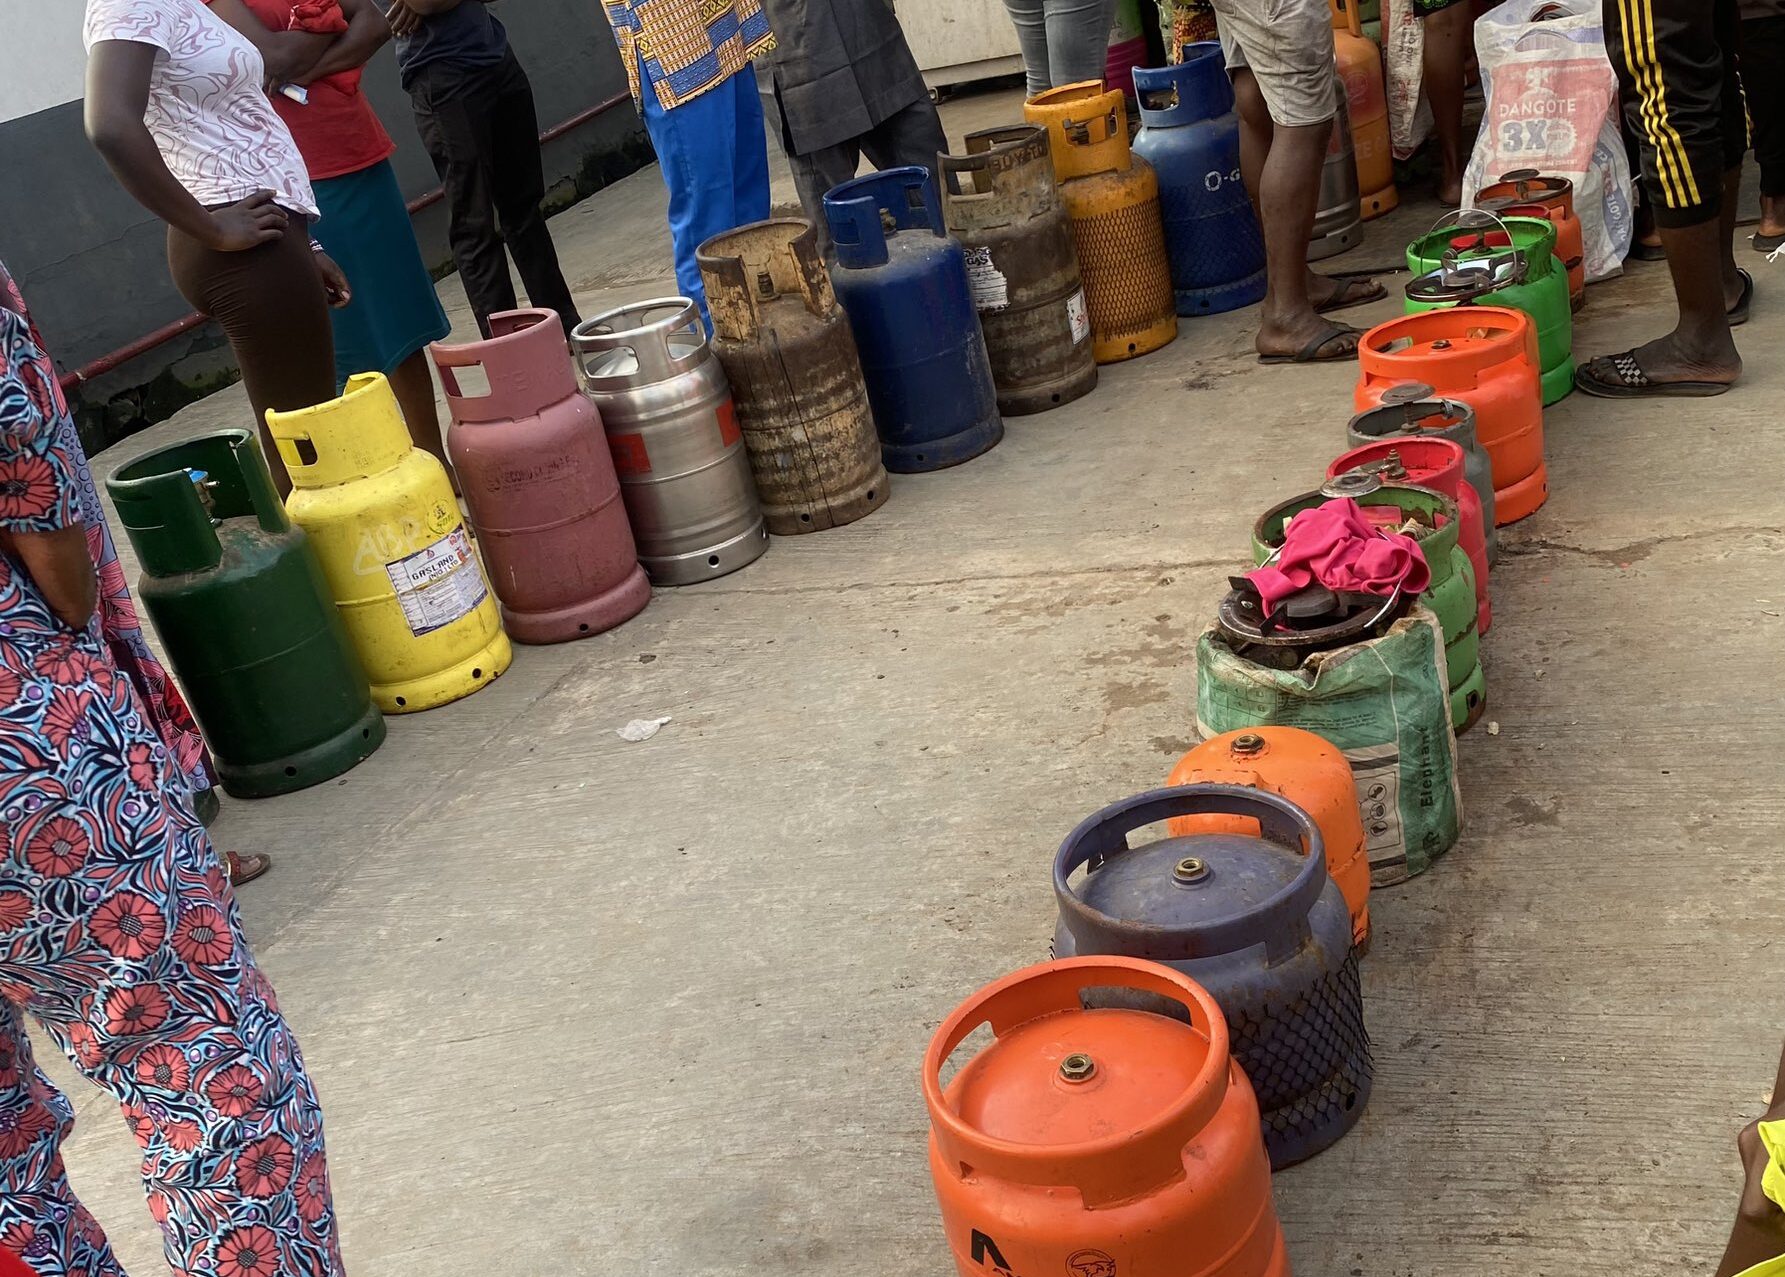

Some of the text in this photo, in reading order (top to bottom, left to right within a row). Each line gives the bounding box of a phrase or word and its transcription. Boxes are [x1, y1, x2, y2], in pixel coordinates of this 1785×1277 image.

[1499, 98, 1577, 118] DANGOTE
[1502, 119, 1548, 153] 3X
[411, 554, 454, 581] GASLAND
[1420, 725, 1435, 809] Elephant
